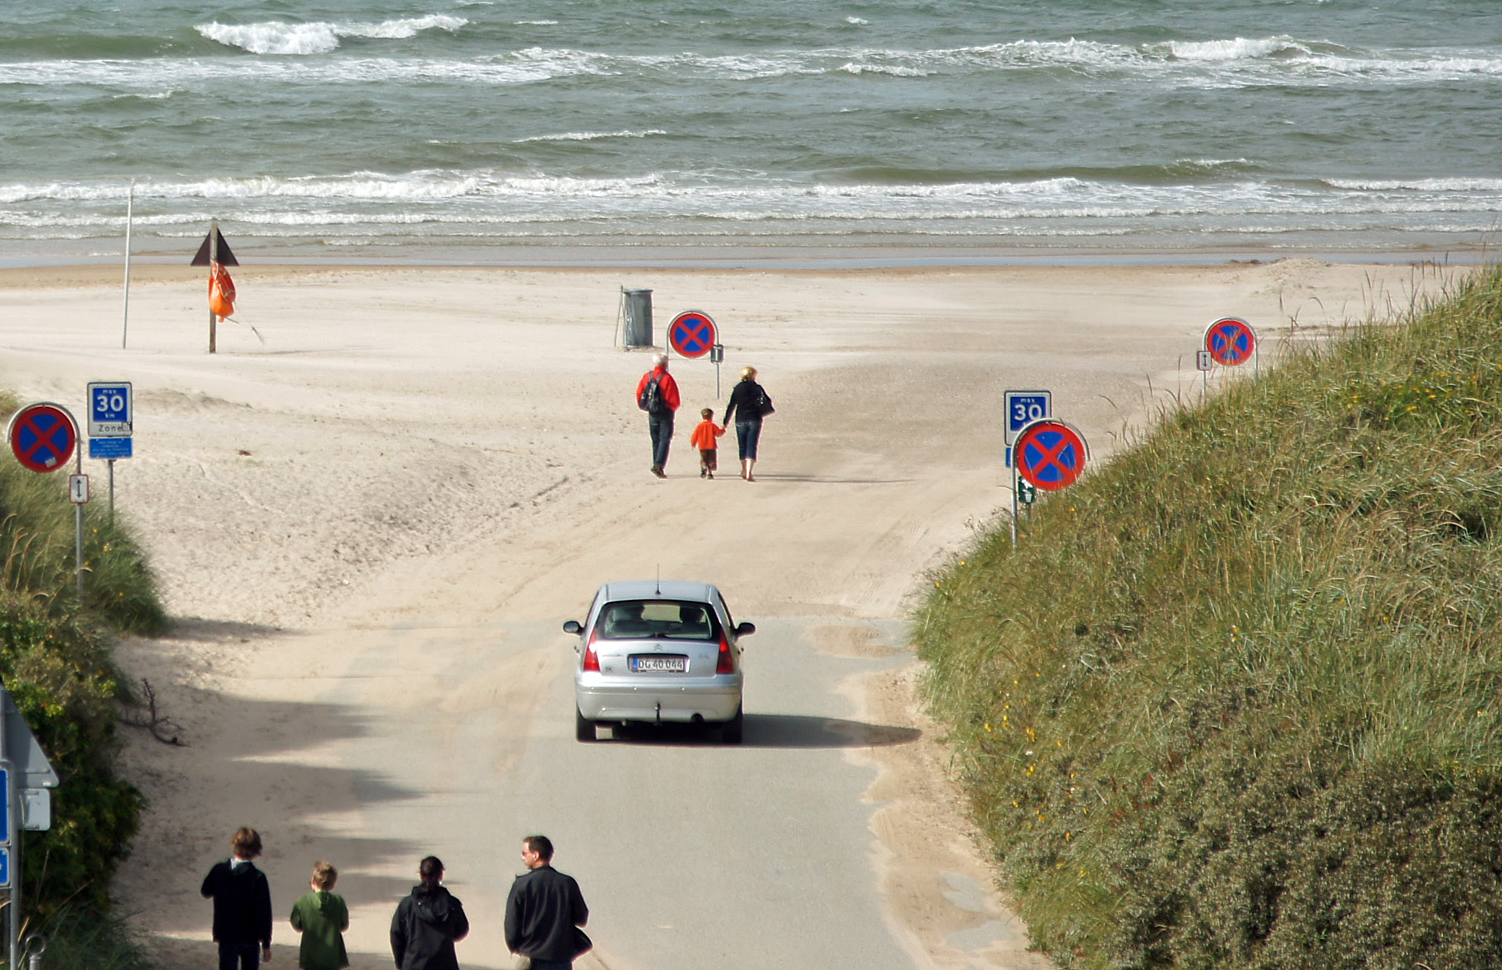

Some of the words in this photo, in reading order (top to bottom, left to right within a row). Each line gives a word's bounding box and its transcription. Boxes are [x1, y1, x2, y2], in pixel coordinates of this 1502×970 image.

[96, 395, 124, 412] 30
[1014, 404, 1043, 421] 30
[98, 424, 123, 433] Zone
[653, 659, 664, 669] 40
[665, 659, 683, 669] 044
